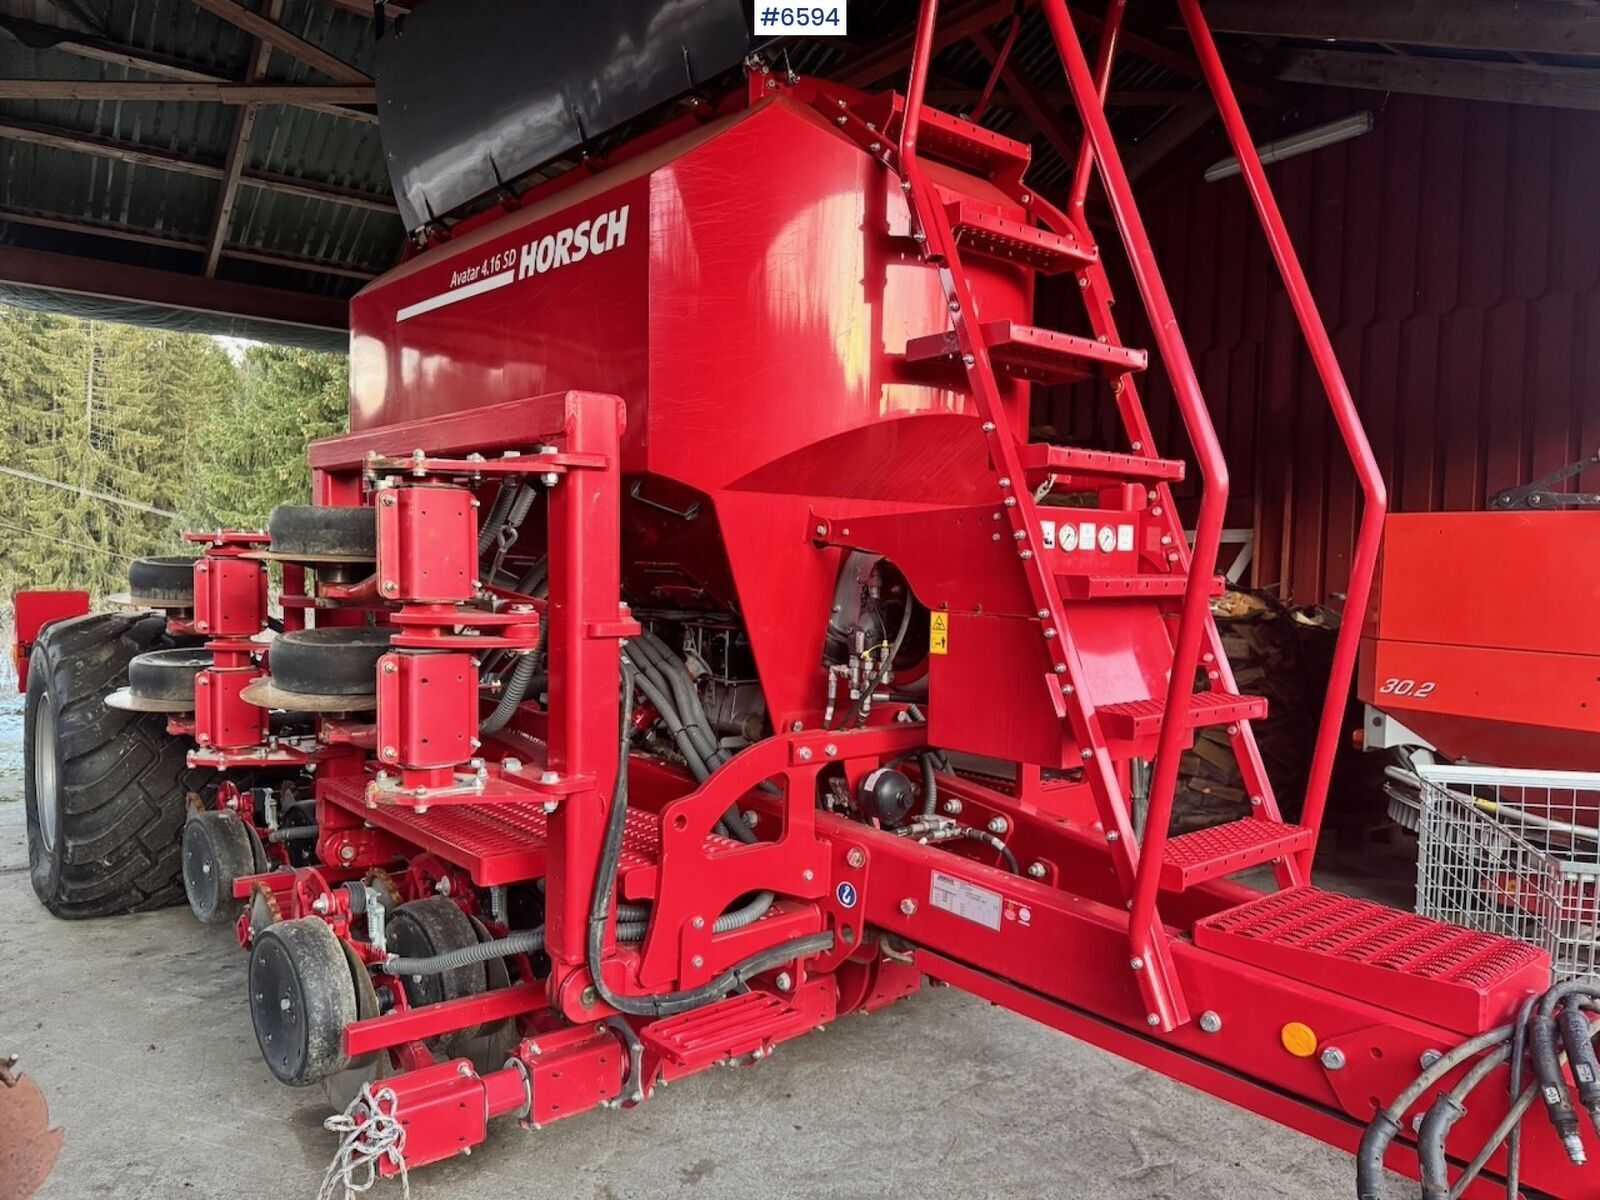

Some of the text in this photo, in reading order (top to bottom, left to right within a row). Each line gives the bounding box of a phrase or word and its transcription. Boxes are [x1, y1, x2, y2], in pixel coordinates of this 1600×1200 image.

[450, 204, 630, 288] Avatar 4.16 SD HORSCH
[1379, 678, 1436, 698] 30.2
